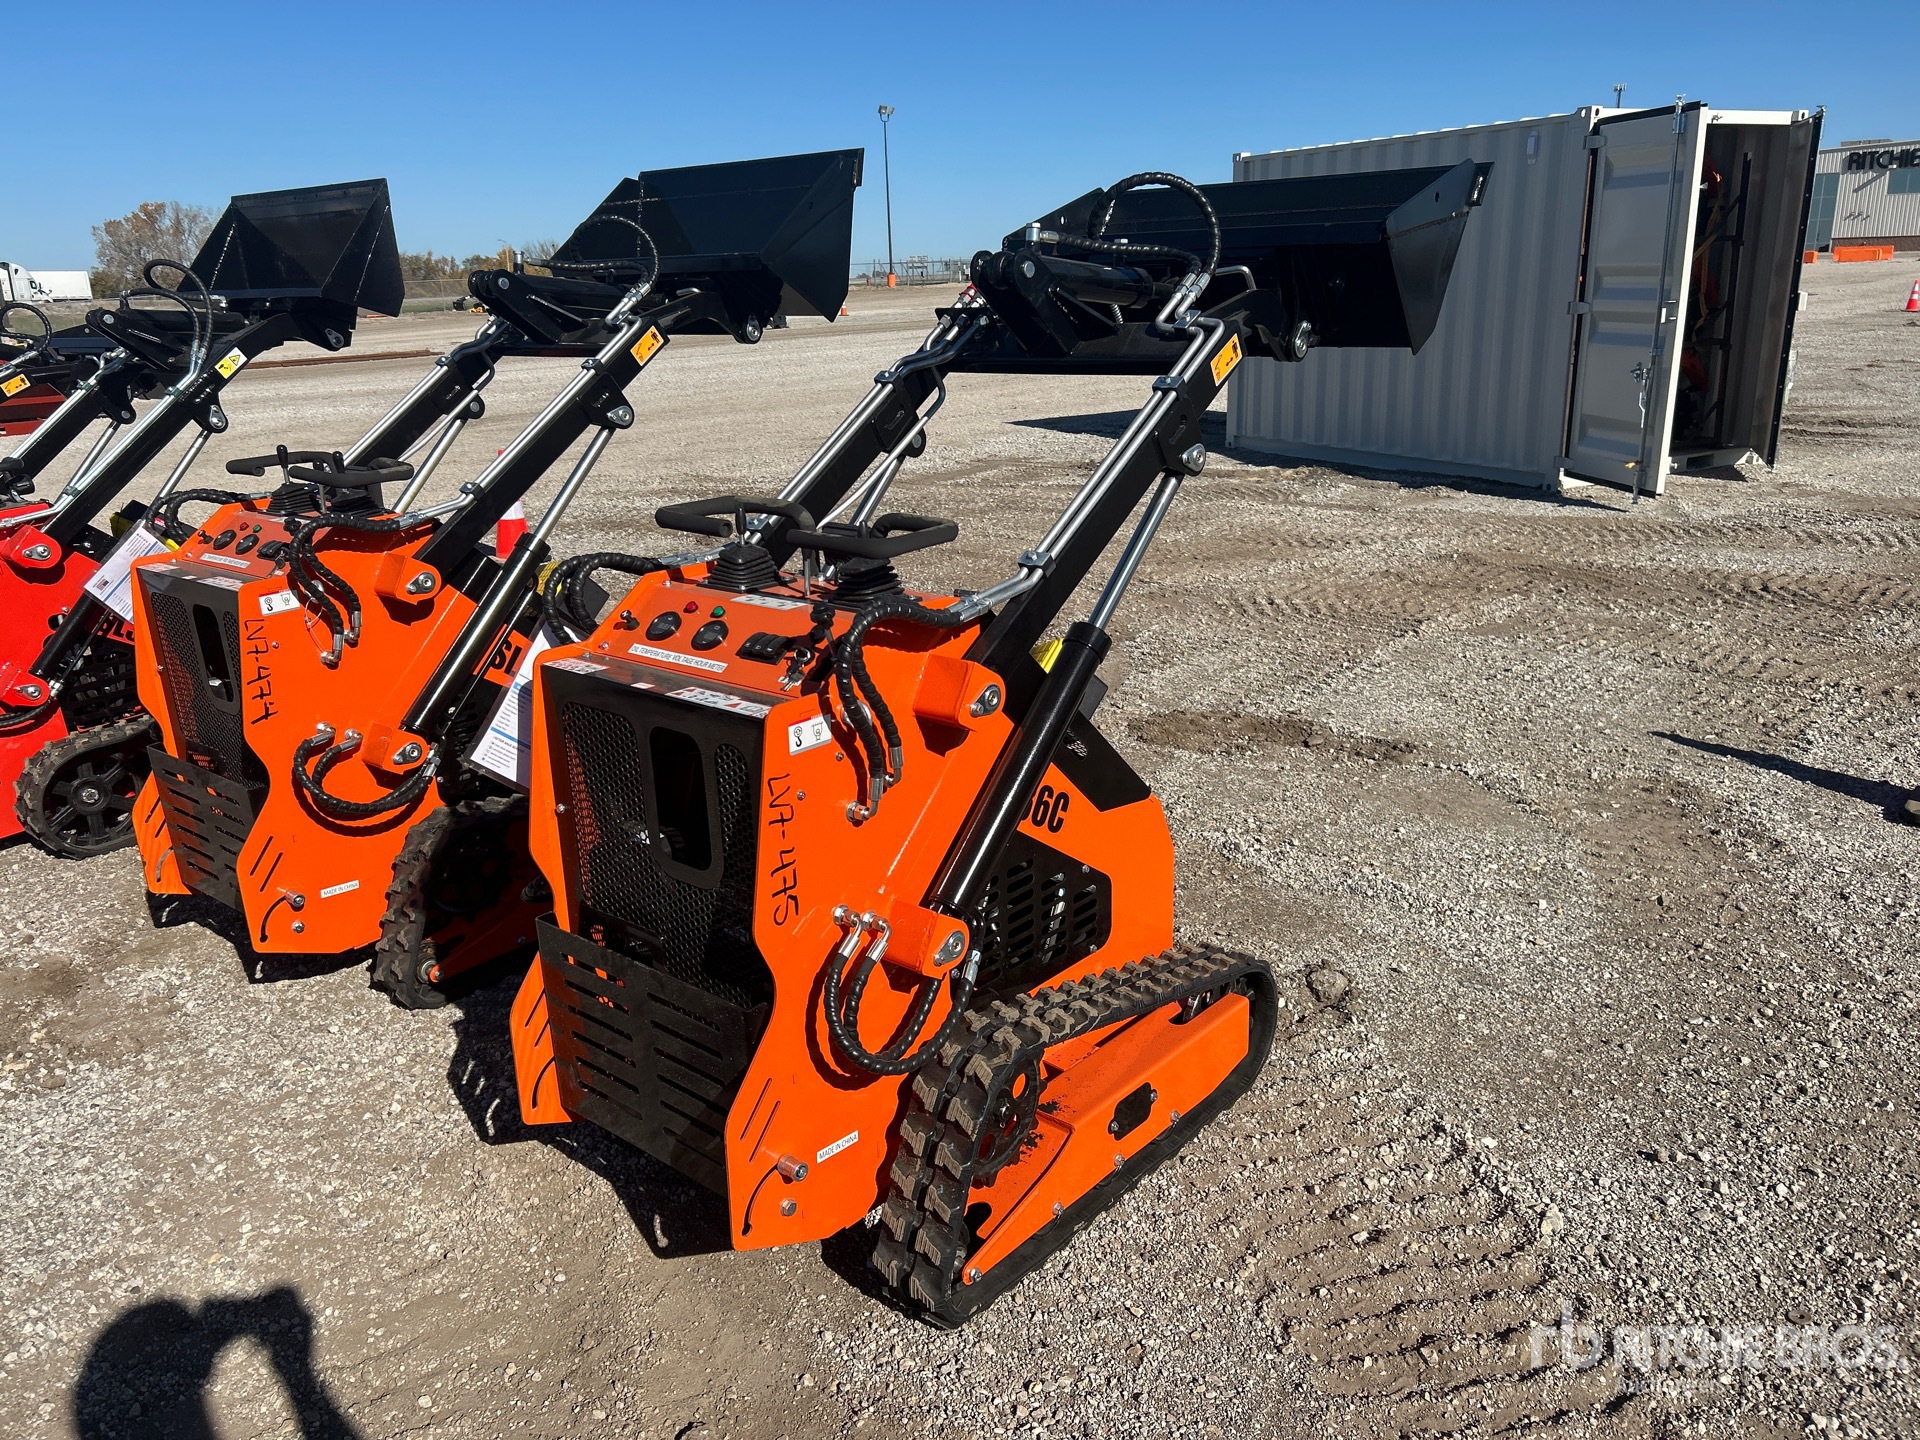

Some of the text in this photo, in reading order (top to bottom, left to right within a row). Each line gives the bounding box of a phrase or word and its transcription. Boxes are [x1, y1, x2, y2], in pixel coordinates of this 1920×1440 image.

[639, 647, 673, 661] TEMPERATURE
[672, 654, 694, 665] VOLTAGE
[693, 659, 710, 668] HOUR
[708, 662, 726, 672] METER
[767, 773, 800, 927] LV7-475
[323, 887, 338, 896] MADE
[343, 882, 359, 891] CHINA
[819, 1133, 858, 1160] MADE IN CHINA
